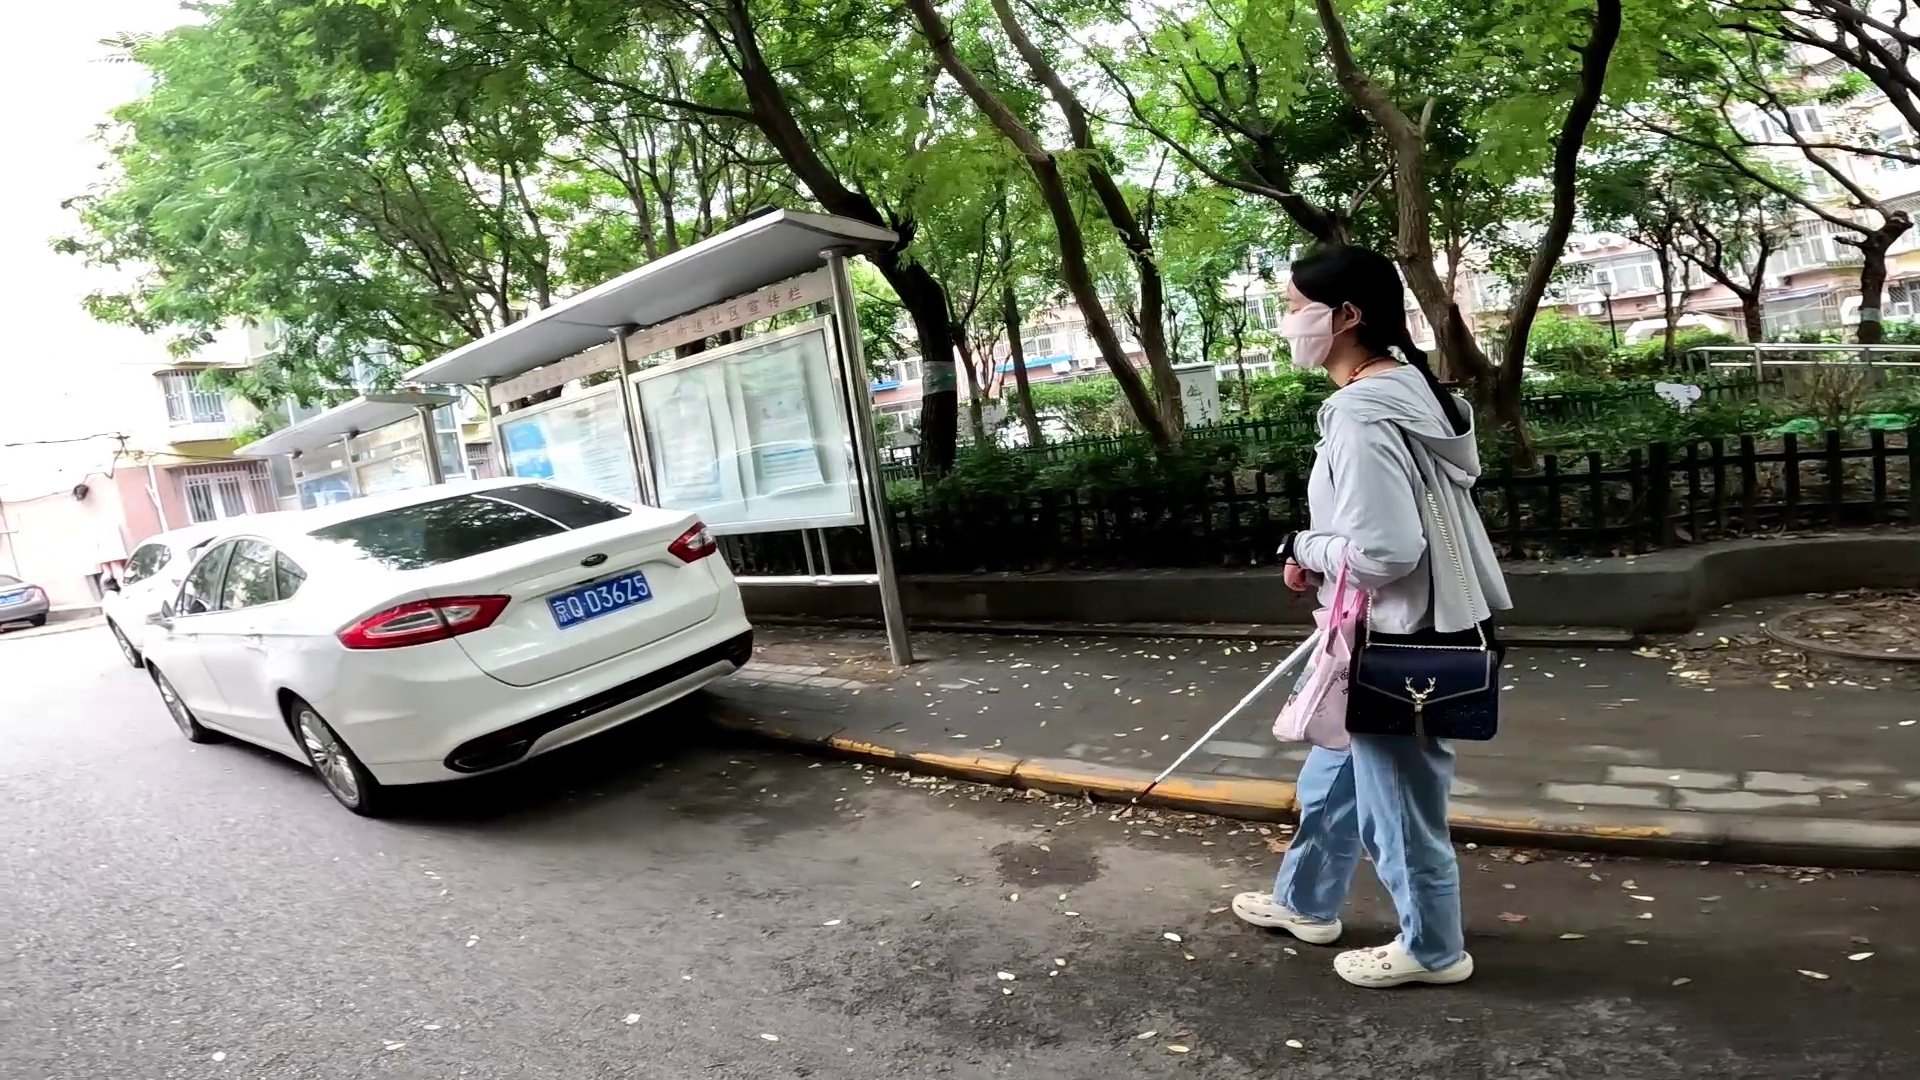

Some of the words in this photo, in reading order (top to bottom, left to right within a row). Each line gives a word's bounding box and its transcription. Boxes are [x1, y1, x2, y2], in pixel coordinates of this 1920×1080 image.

[641, 285, 803, 347] 街道社区宣传栏
